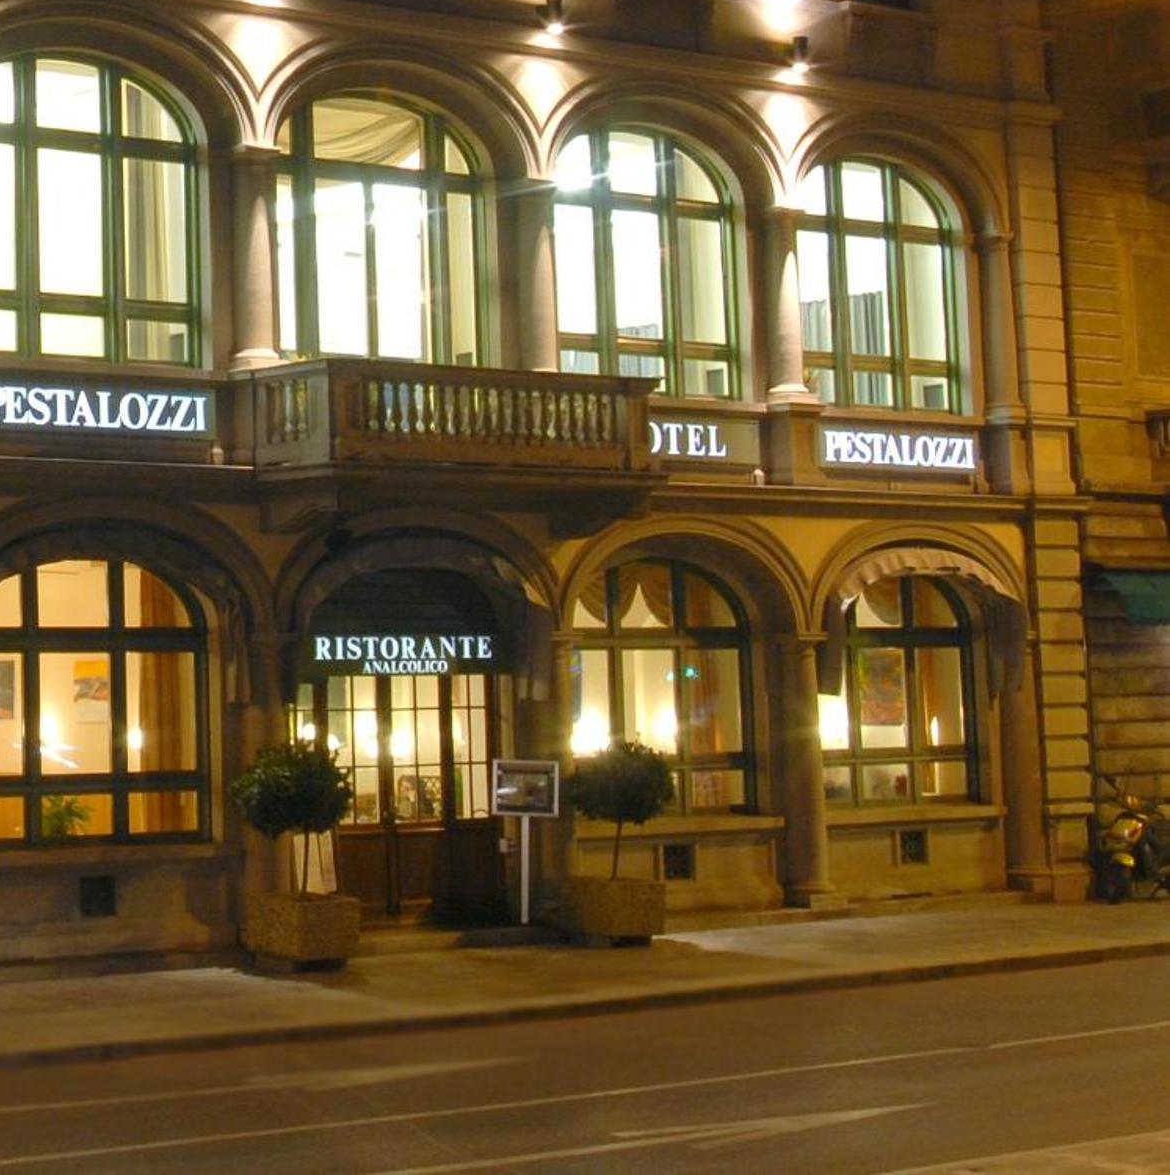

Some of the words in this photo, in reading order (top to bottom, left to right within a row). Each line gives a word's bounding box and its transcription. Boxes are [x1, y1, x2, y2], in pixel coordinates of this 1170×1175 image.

[649, 421, 727, 457] OTEL
[825, 430, 975, 469] PESTALOZZI
[314, 635, 493, 661] RISTORANTE
[363, 659, 449, 675] ANALCOLICO
